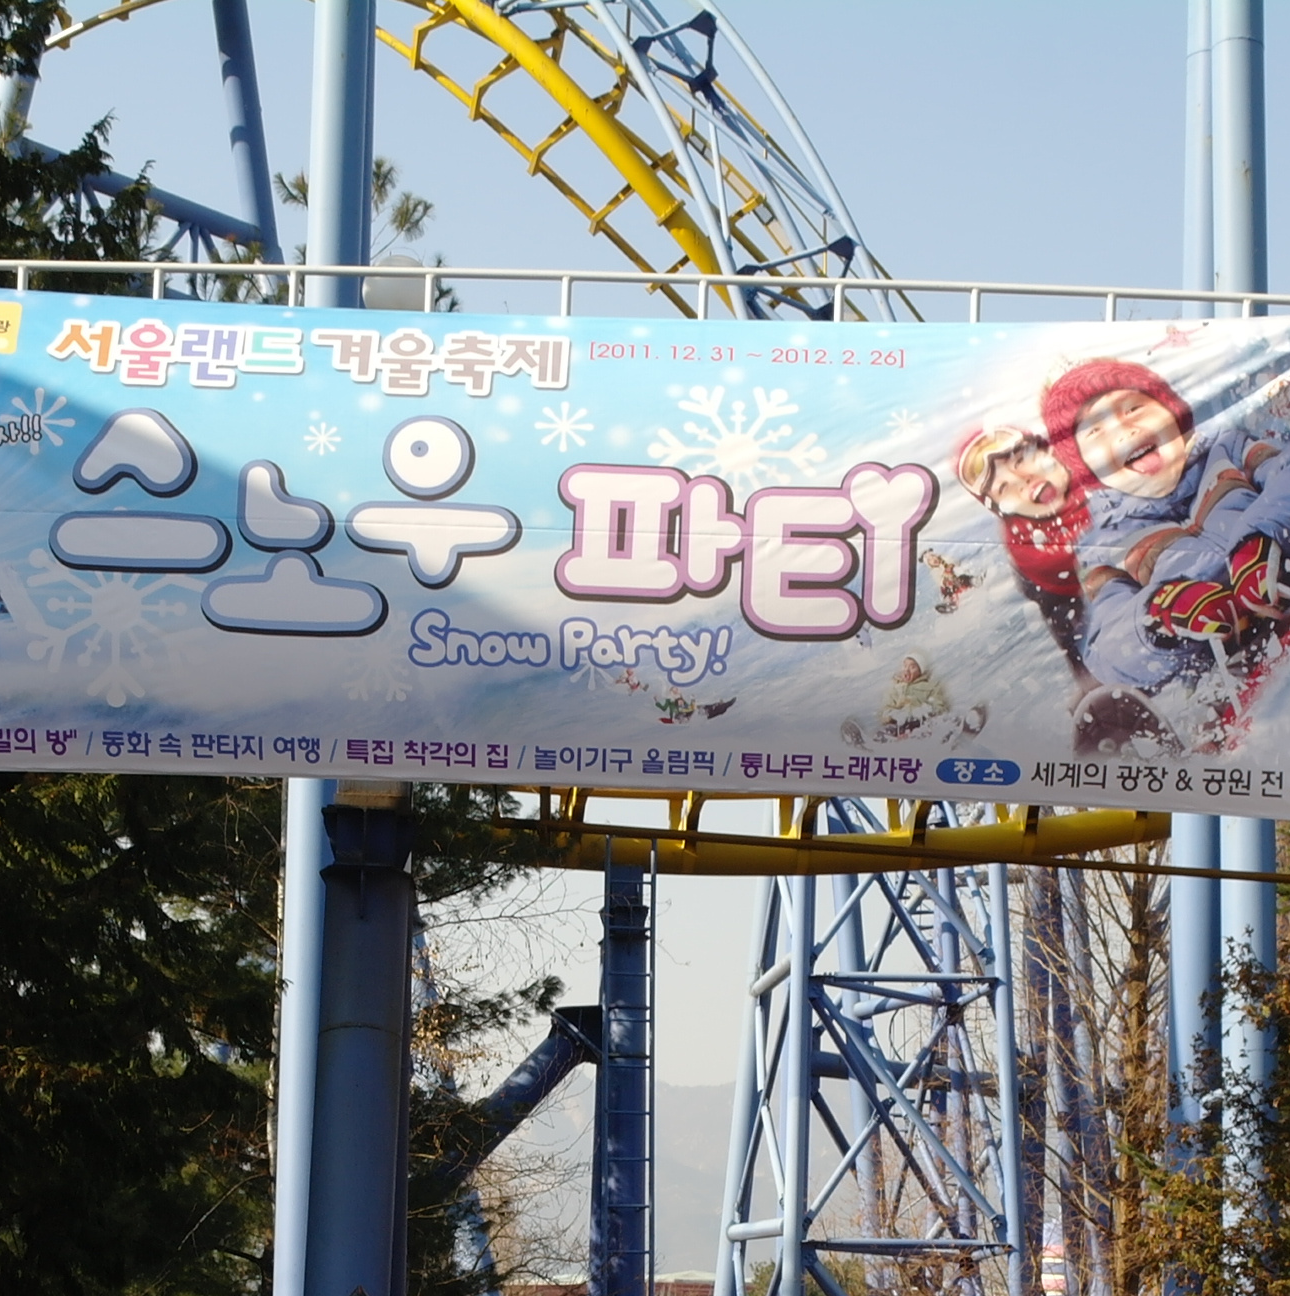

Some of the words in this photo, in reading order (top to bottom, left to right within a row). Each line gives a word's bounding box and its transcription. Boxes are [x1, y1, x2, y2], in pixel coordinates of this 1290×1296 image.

[54, 323, 298, 382] 서울랜드
[316, 332, 564, 391] 겨울축제
[590, 341, 659, 360] [2011.
[670, 345, 701, 360] 12.
[710, 346, 735, 361] 31
[771, 348, 832, 364] 2012.
[870, 349, 905, 368] 26]
[49, 407, 523, 637] 스노우
[554, 462, 940, 642] 파티
[409, 607, 550, 669] Snow
[559, 617, 734, 686] Party!
[46, 729, 77, 756] 방"
[101, 731, 151, 757] 동화
[159, 733, 182, 757] 속
[191, 734, 264, 761] 판타지
[273, 736, 320, 763] 여행
[346, 738, 394, 765] 특집
[404, 740, 477, 768] 착각의
[486, 743, 509, 769] 집
[534, 745, 633, 773] 놀이기구
[641, 748, 715, 776] 올림픽
[740, 752, 813, 779] 통나무
[822, 755, 923, 784] 노래자랑
[1031, 761, 1107, 788] 세계의
[1116, 764, 1168, 793] 광장
[1175, 768, 1194, 791] &
[1202, 768, 1251, 796] 공원
[1259, 769, 1284, 798] 전
